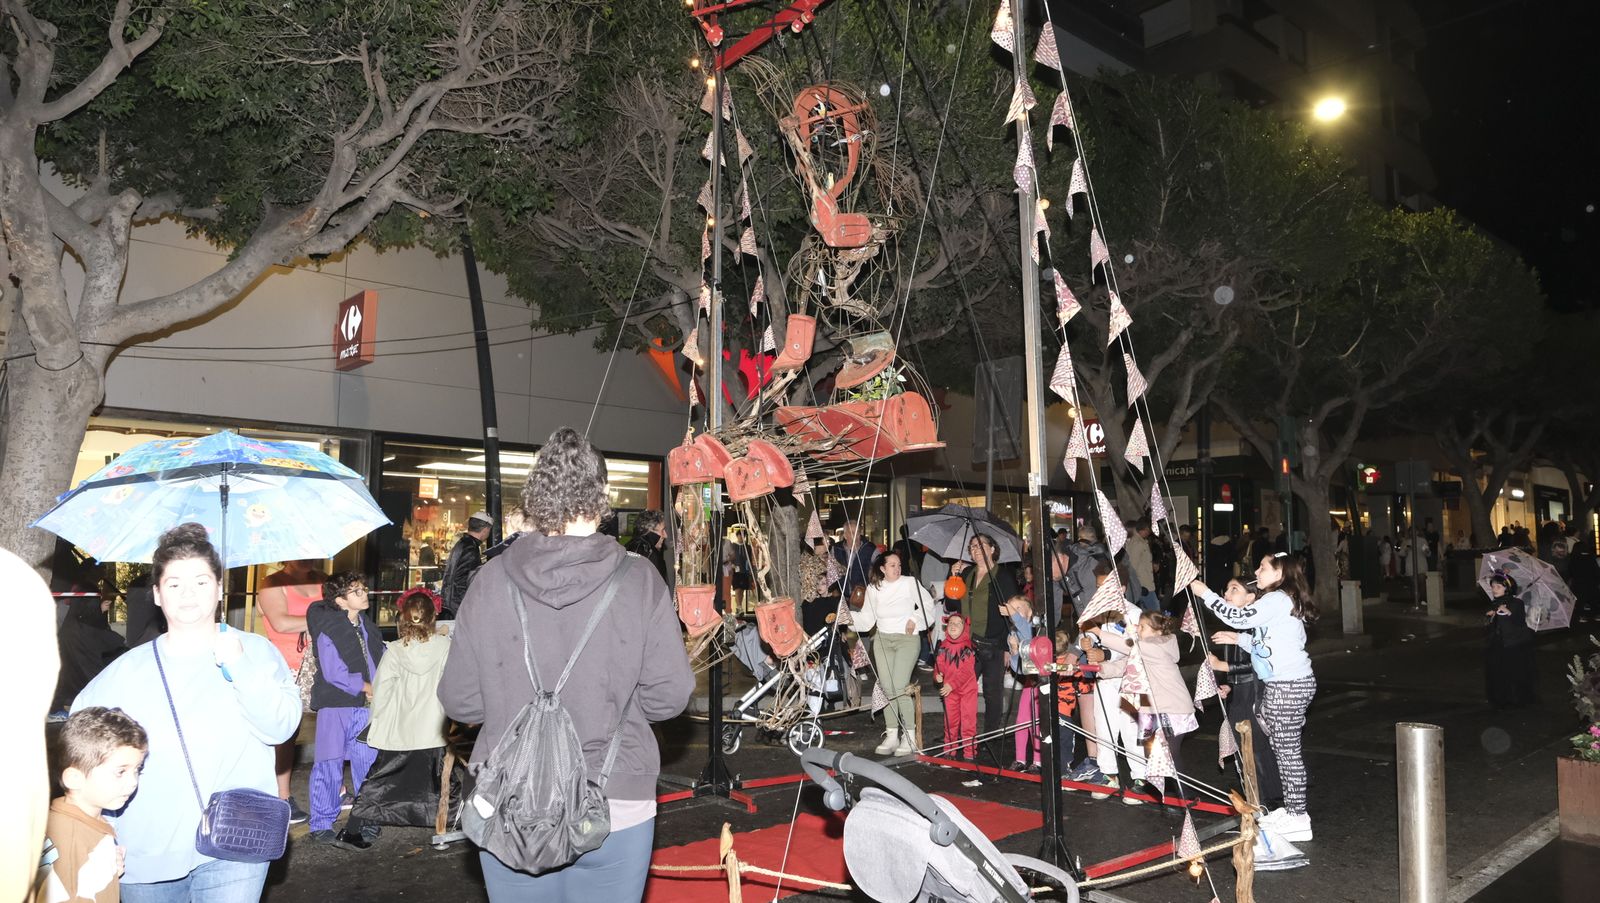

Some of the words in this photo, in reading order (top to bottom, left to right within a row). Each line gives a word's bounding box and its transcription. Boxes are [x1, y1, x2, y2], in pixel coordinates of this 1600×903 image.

[340, 343, 359, 360] market
[1088, 445, 1106, 453] arket
[1166, 464, 1195, 476] nicaja
